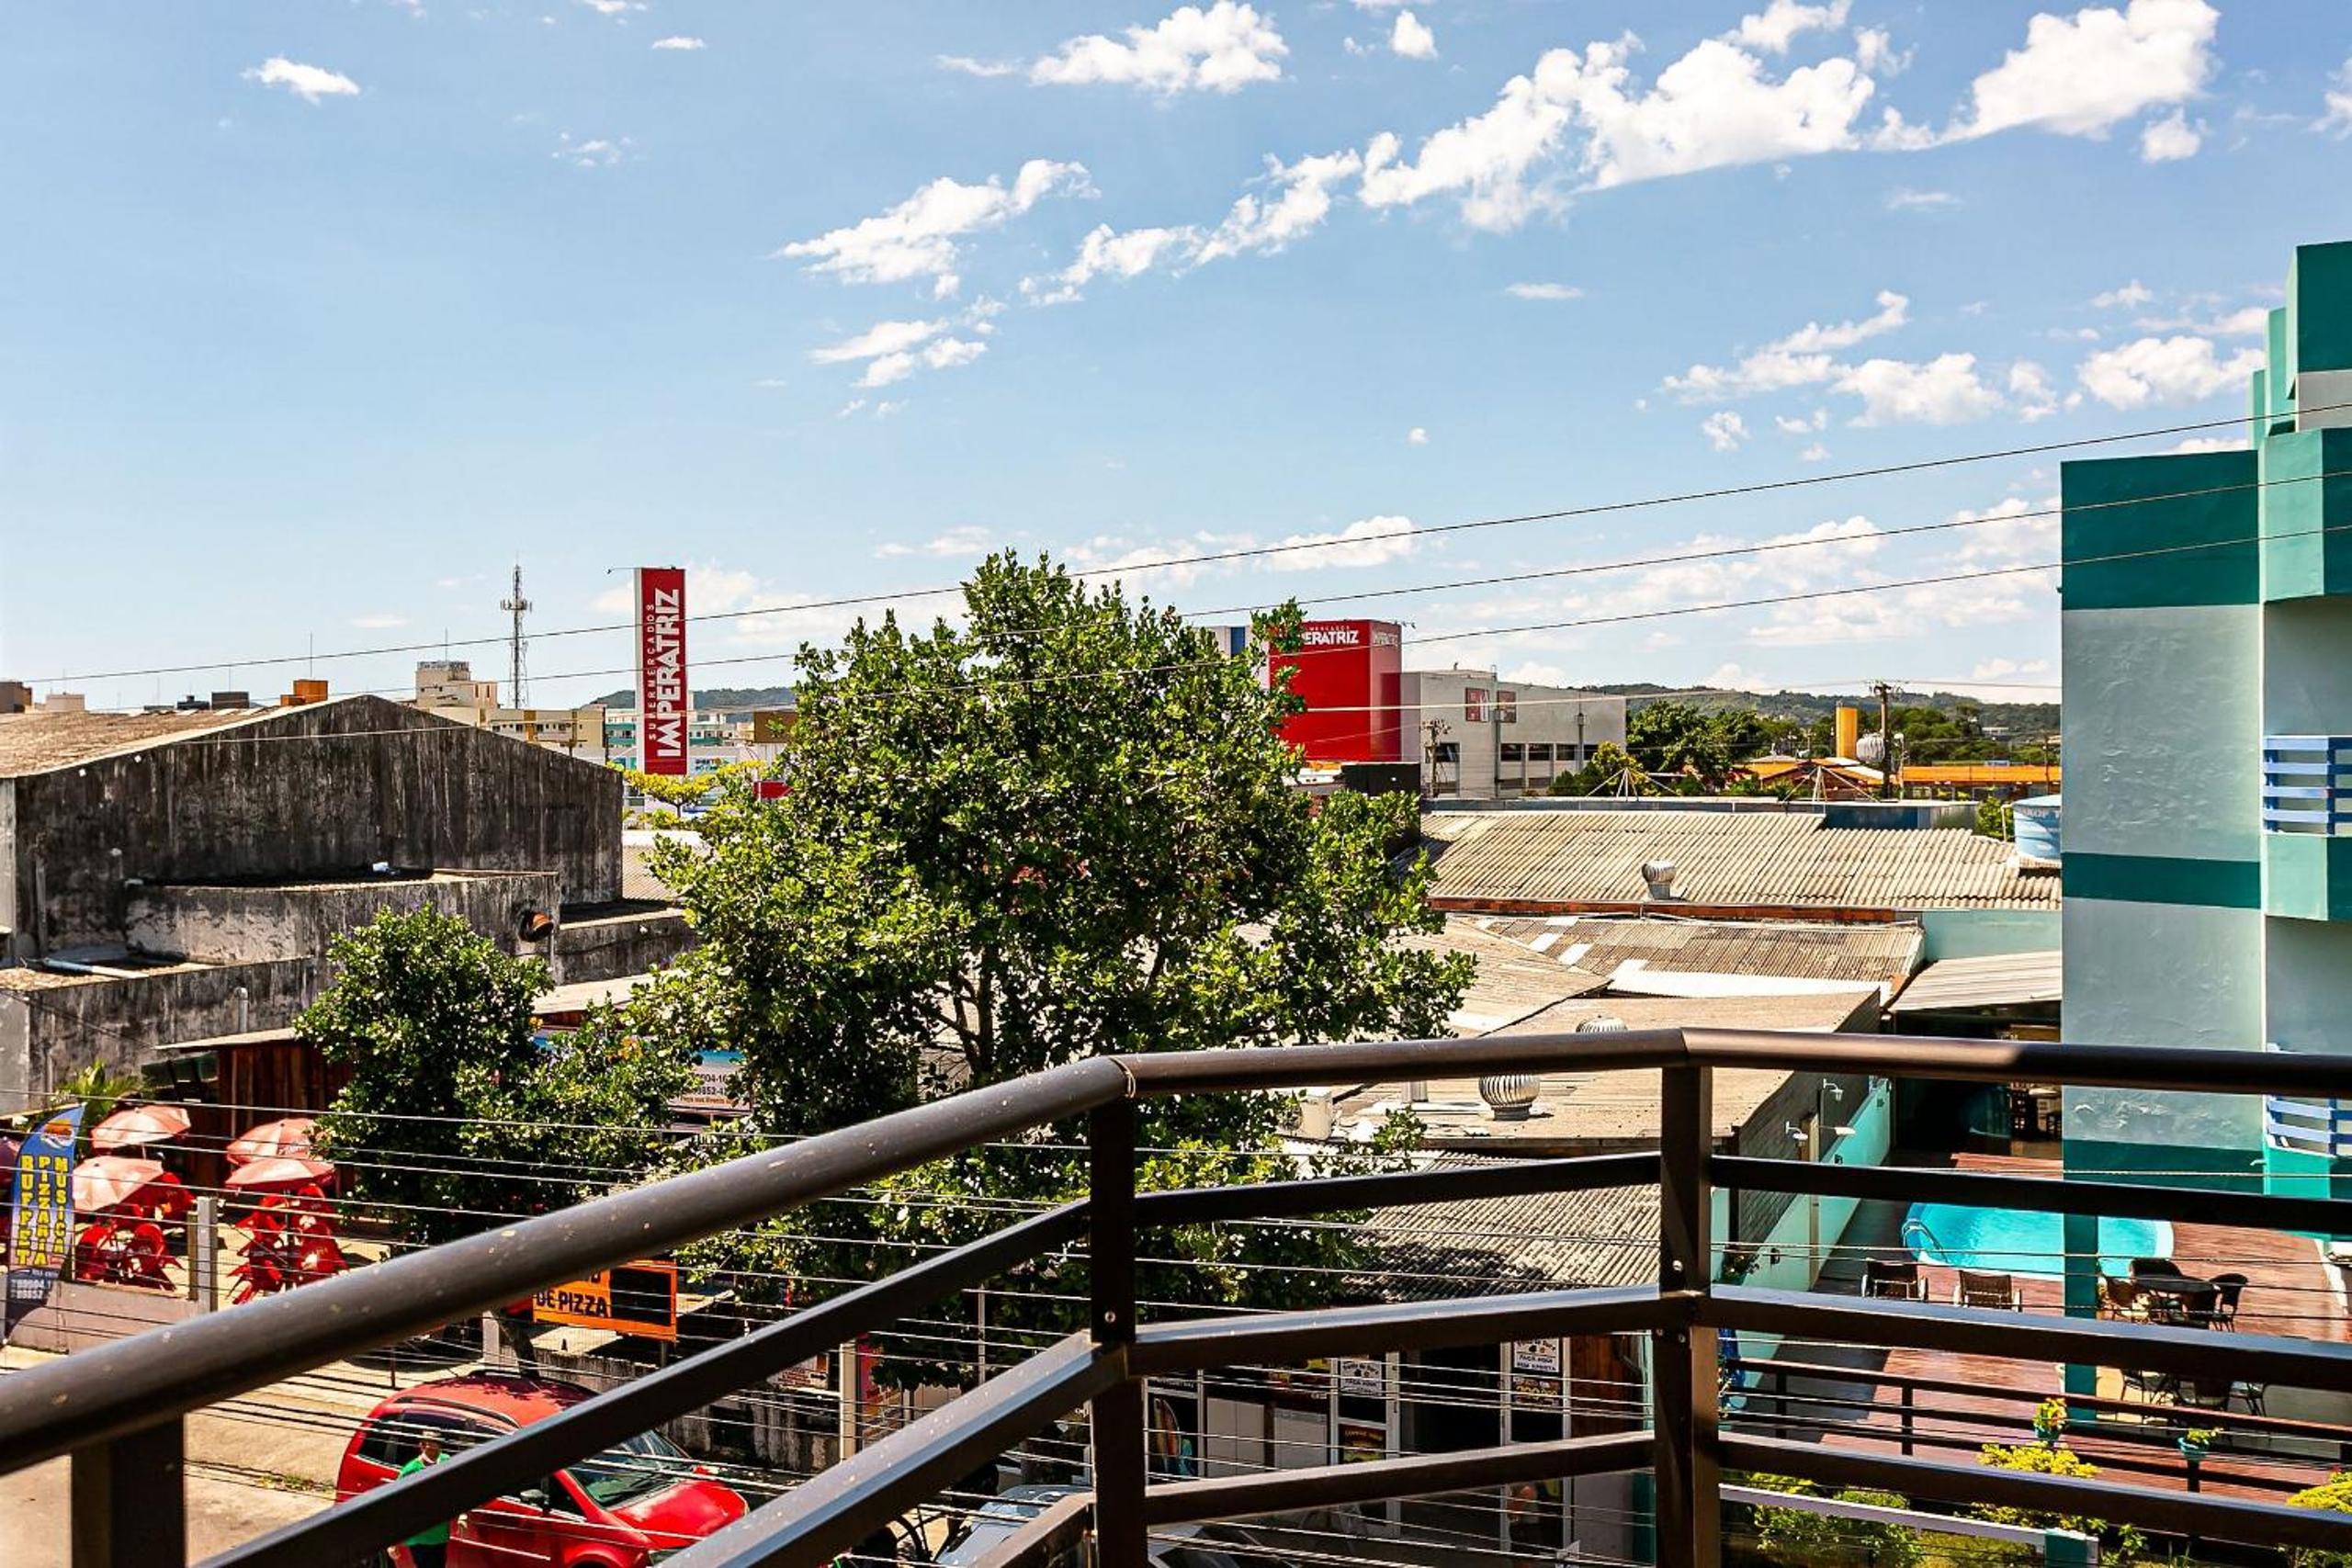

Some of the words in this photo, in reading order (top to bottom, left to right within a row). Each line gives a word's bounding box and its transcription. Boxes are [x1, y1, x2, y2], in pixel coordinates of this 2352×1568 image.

[1303, 630, 1359, 645] ERATRIZ
[655, 588, 681, 757] IMPERATRIZ
[17, 1155, 34, 1265] BUFFET
[537, 1290, 556, 1309] DE
[558, 1291, 608, 1318] PIZZA
